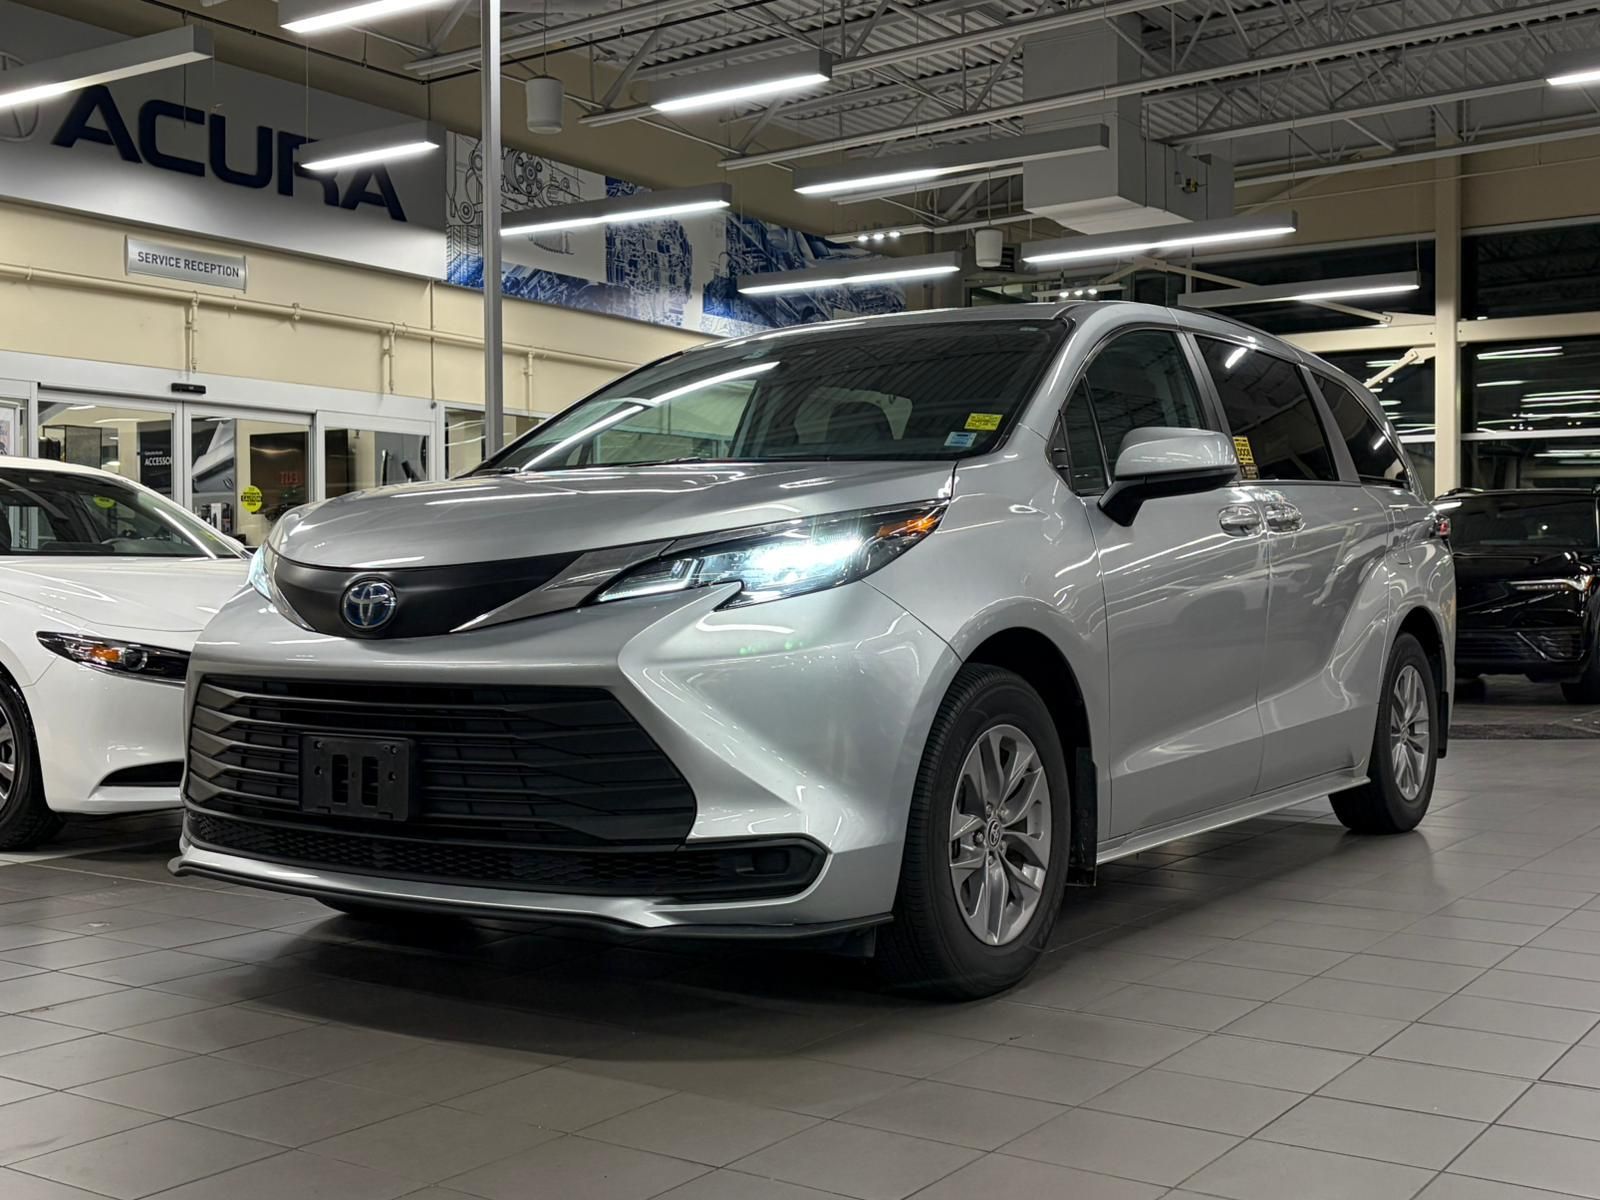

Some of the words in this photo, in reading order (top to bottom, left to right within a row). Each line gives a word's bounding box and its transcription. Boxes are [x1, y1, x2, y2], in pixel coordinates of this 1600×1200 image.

[52, 84, 407, 222] ACURA
[138, 251, 182, 269] SERVICE
[184, 258, 239, 278] RECEPTION
[145, 456, 172, 466] ACCESSO
